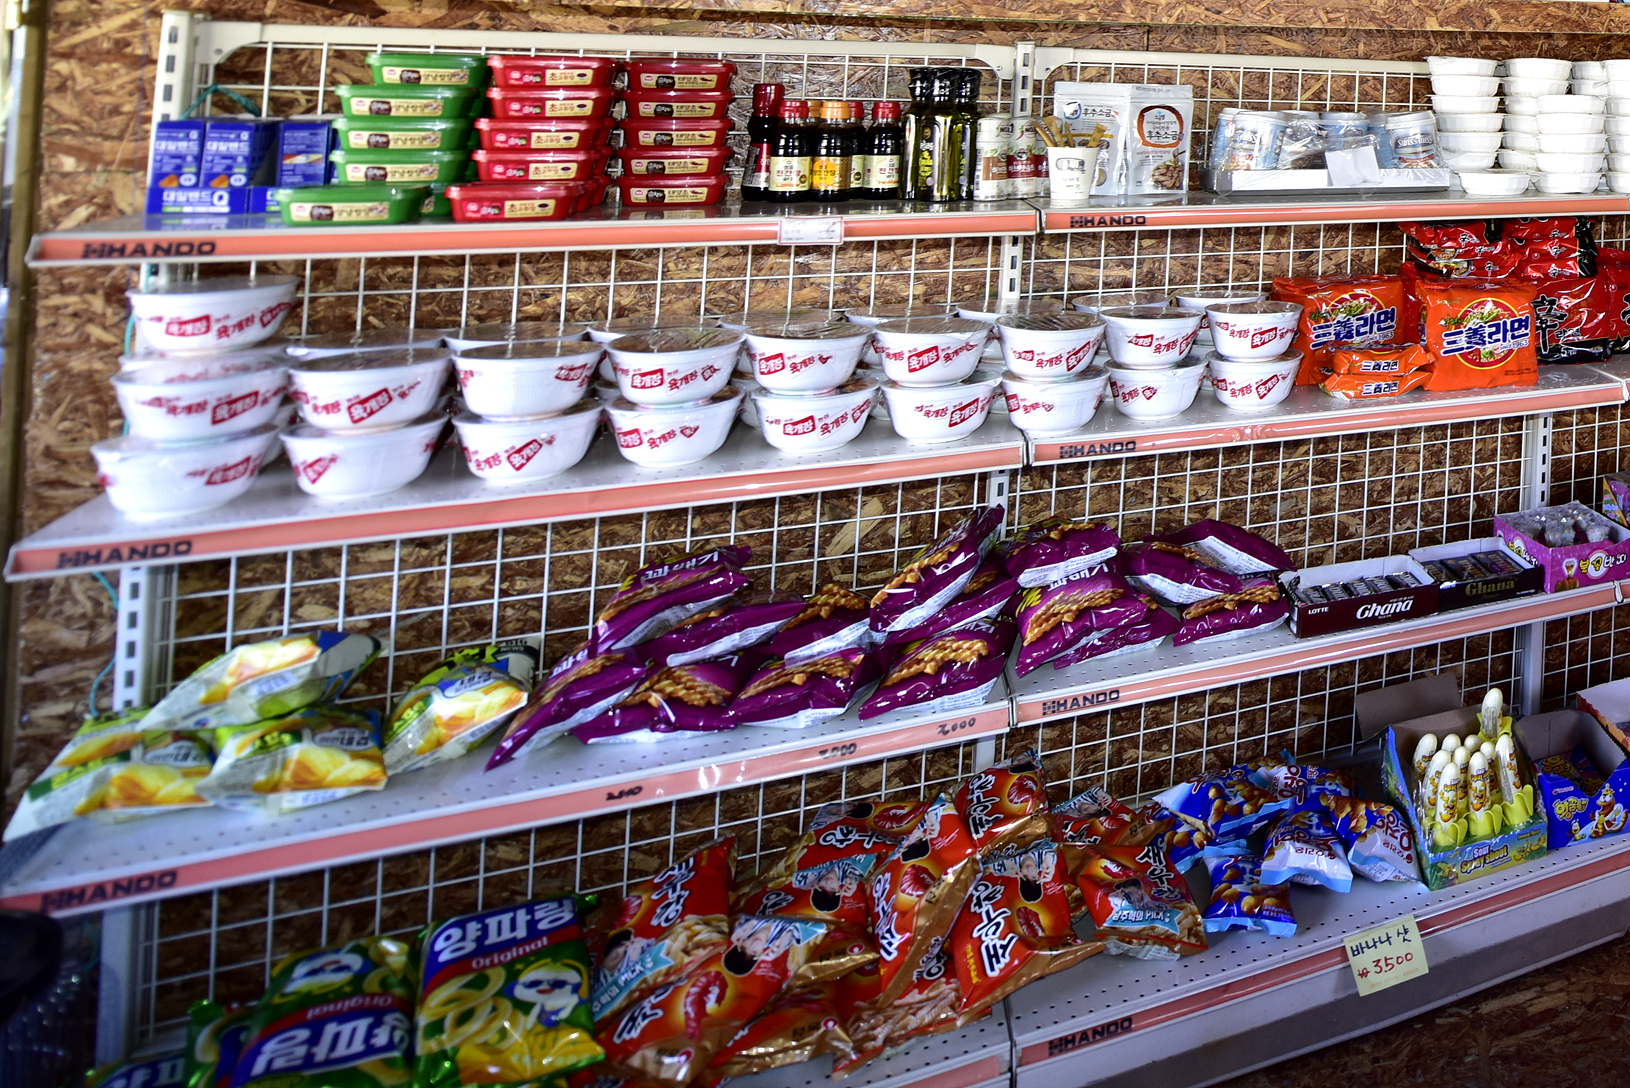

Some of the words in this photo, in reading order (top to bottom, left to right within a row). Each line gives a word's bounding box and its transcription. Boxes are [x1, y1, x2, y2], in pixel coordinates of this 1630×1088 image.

[1082, 107, 1112, 118] 후추소금
[1146, 129, 1179, 141] 후추소금
[776, 169, 802, 178] 진간장
[1085, 216, 1147, 227] HANDO
[106, 239, 216, 259] HANDO
[1378, 330, 1394, 341] 1963
[1441, 314, 1531, 357] 三養라면
[1513, 339, 1529, 350] 1963
[907, 345, 939, 374] 육개장
[949, 399, 979, 428] 육개장
[784, 416, 815, 436] 육개장
[1073, 440, 1137, 458] HANDO
[84, 540, 192, 566] HANDO
[1464, 578, 1516, 598] Ghana
[1308, 606, 1329, 615] LOTTE
[1355, 598, 1414, 620] Ghana
[1056, 688, 1120, 714] HANDO
[967, 771, 1005, 840] 새우깡
[1294, 846, 1332, 859] 오리온
[1472, 844, 1491, 859] Sour
[1135, 844, 1183, 902] 새우깡
[78, 870, 177, 904] HANDO
[1145, 908, 1166, 921] PICK
[432, 898, 576, 964] 양파링
[971, 878, 1020, 978] 새우깡
[1350, 932, 1393, 958] 바나나
[1396, 925, 1412, 943] 샷
[470, 934, 550, 972] Original
[307, 992, 394, 1019] Original
[1062, 1016, 1133, 1050] HANDO
